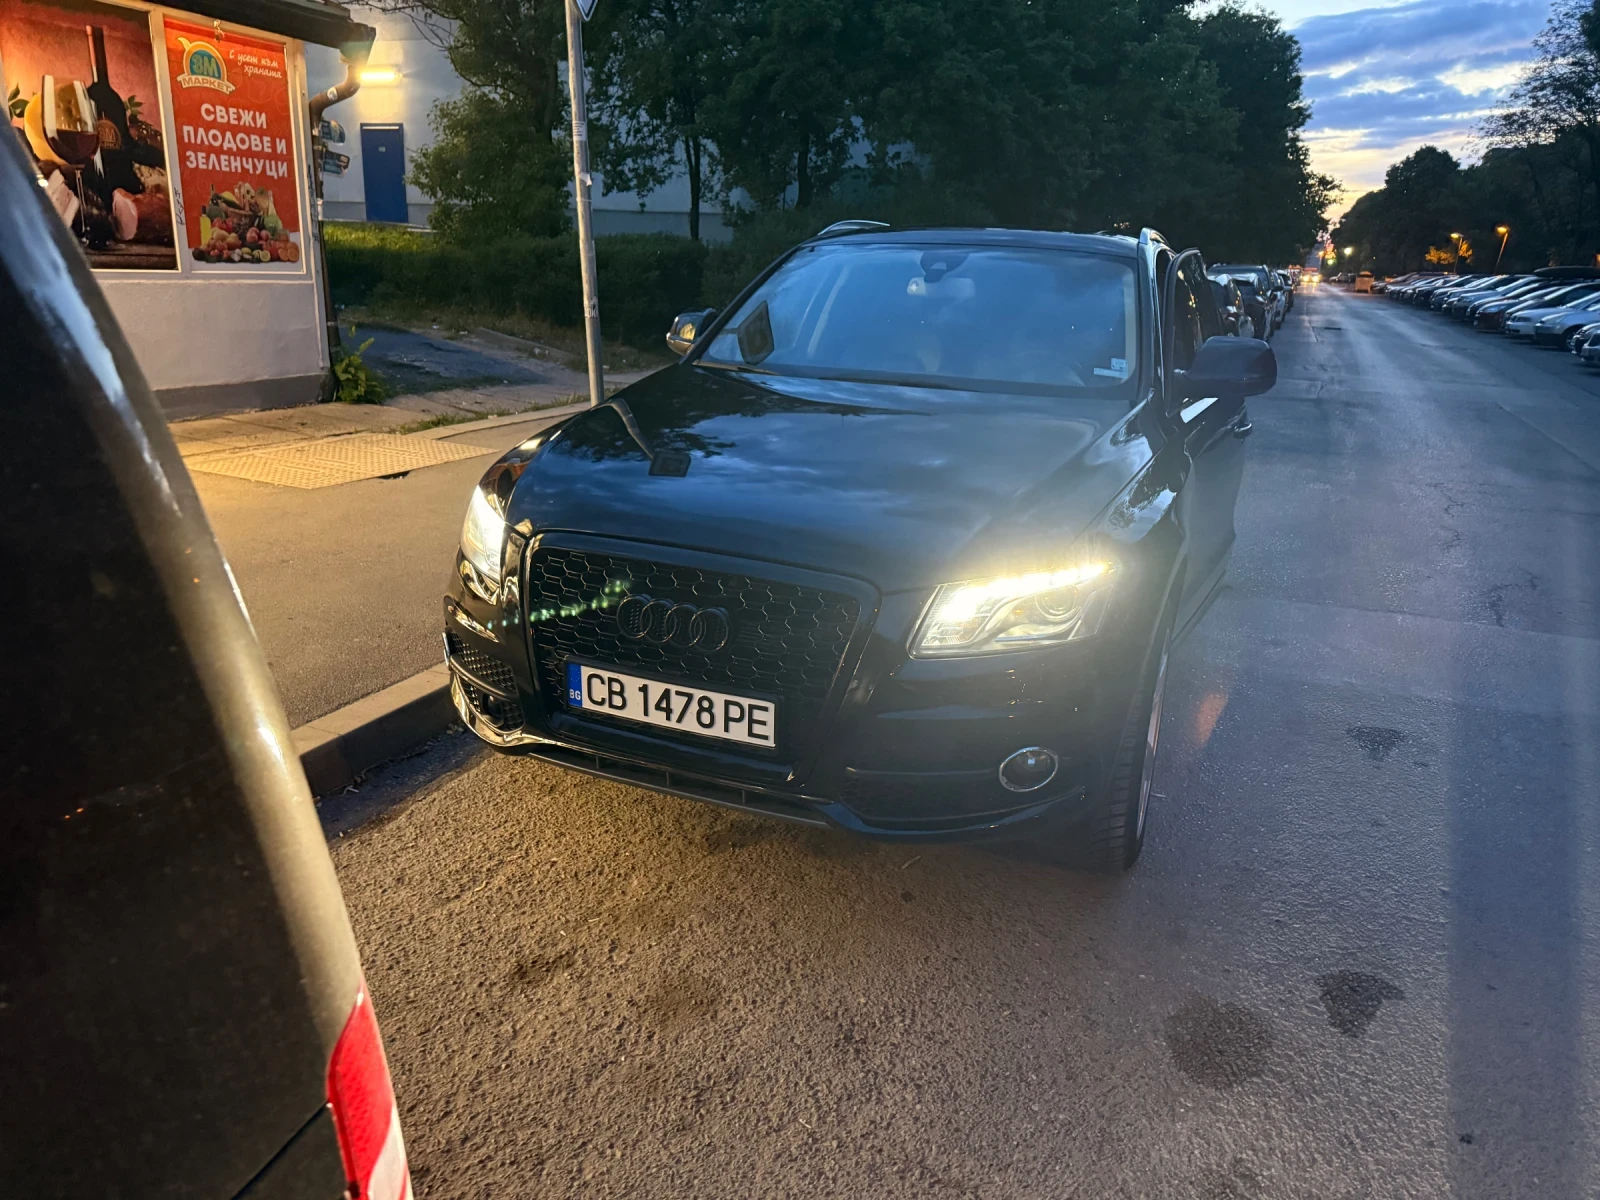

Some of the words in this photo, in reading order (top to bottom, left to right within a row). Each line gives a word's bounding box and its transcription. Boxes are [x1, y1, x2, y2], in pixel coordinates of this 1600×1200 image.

[237, 53, 258, 66] усет
[261, 57, 278, 69] към
[244, 64, 283, 79] храната
[182, 77, 233, 94] МАРКЕТ
[201, 103, 267, 129] СВЕЖИ
[182, 125, 272, 153] ПЛОДОВЕ
[276, 138, 287, 155] И
[185, 150, 288, 179] ЗЕЛЕНЧУЦИ
[569, 689, 581, 700] BG
[586, 673, 627, 711] CB
[638, 683, 715, 729] 1478
[723, 698, 769, 741] PE
